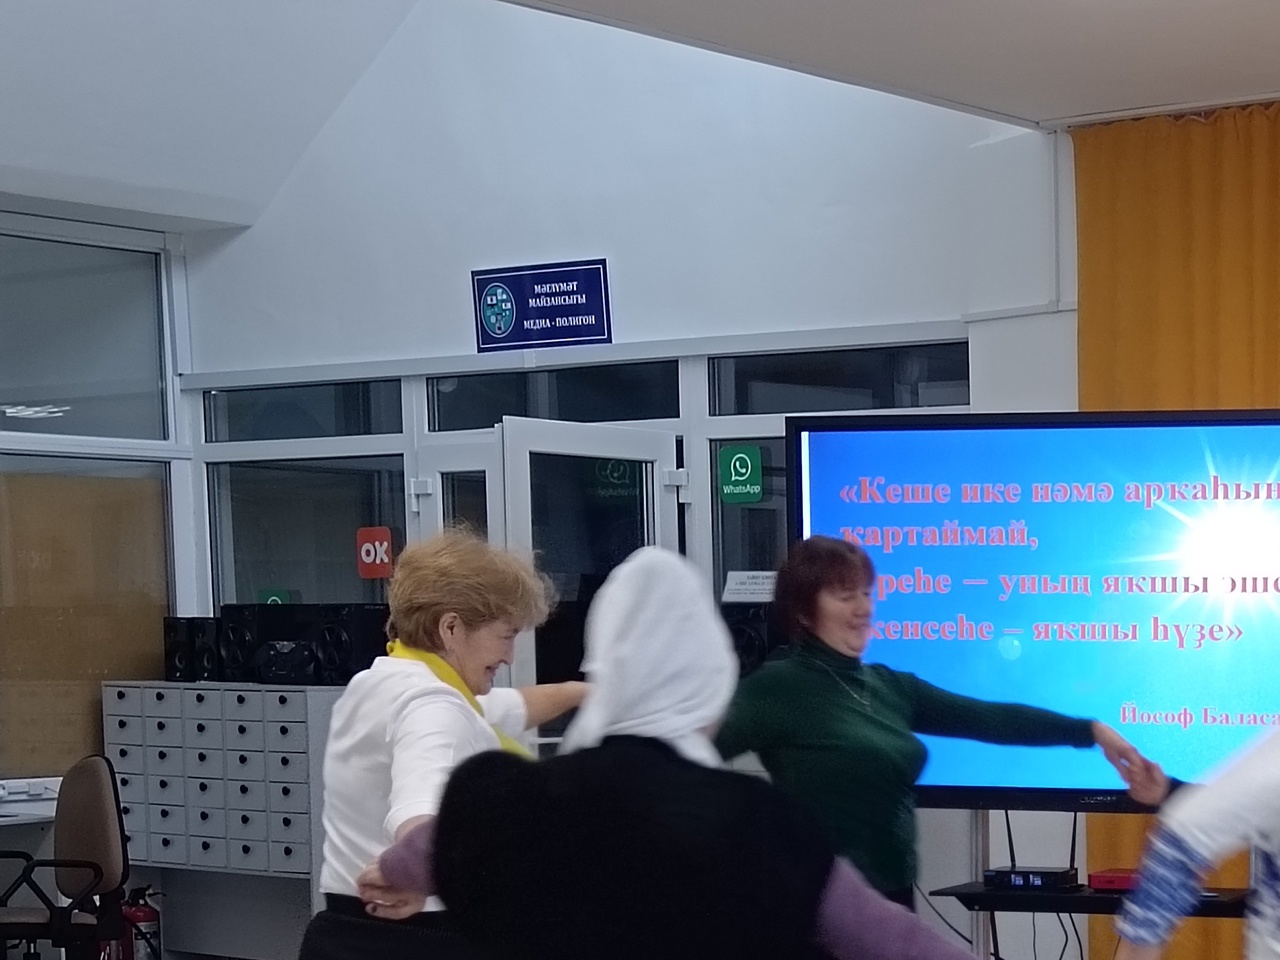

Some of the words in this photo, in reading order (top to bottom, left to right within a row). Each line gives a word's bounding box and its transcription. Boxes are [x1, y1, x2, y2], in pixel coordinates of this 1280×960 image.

[556, 315, 596, 327] ПОЛИГОН
[723, 484, 761, 494] WhatsApp
[840, 476, 951, 503] «Кеше
[961, 483, 1021, 503] ике
[1032, 482, 1114, 503] нәмә
[876, 567, 952, 600] реһе
[999, 574, 1092, 601] уның
[866, 614, 995, 641] кенсеһе
[1120, 702, 1195, 729] Йософ
